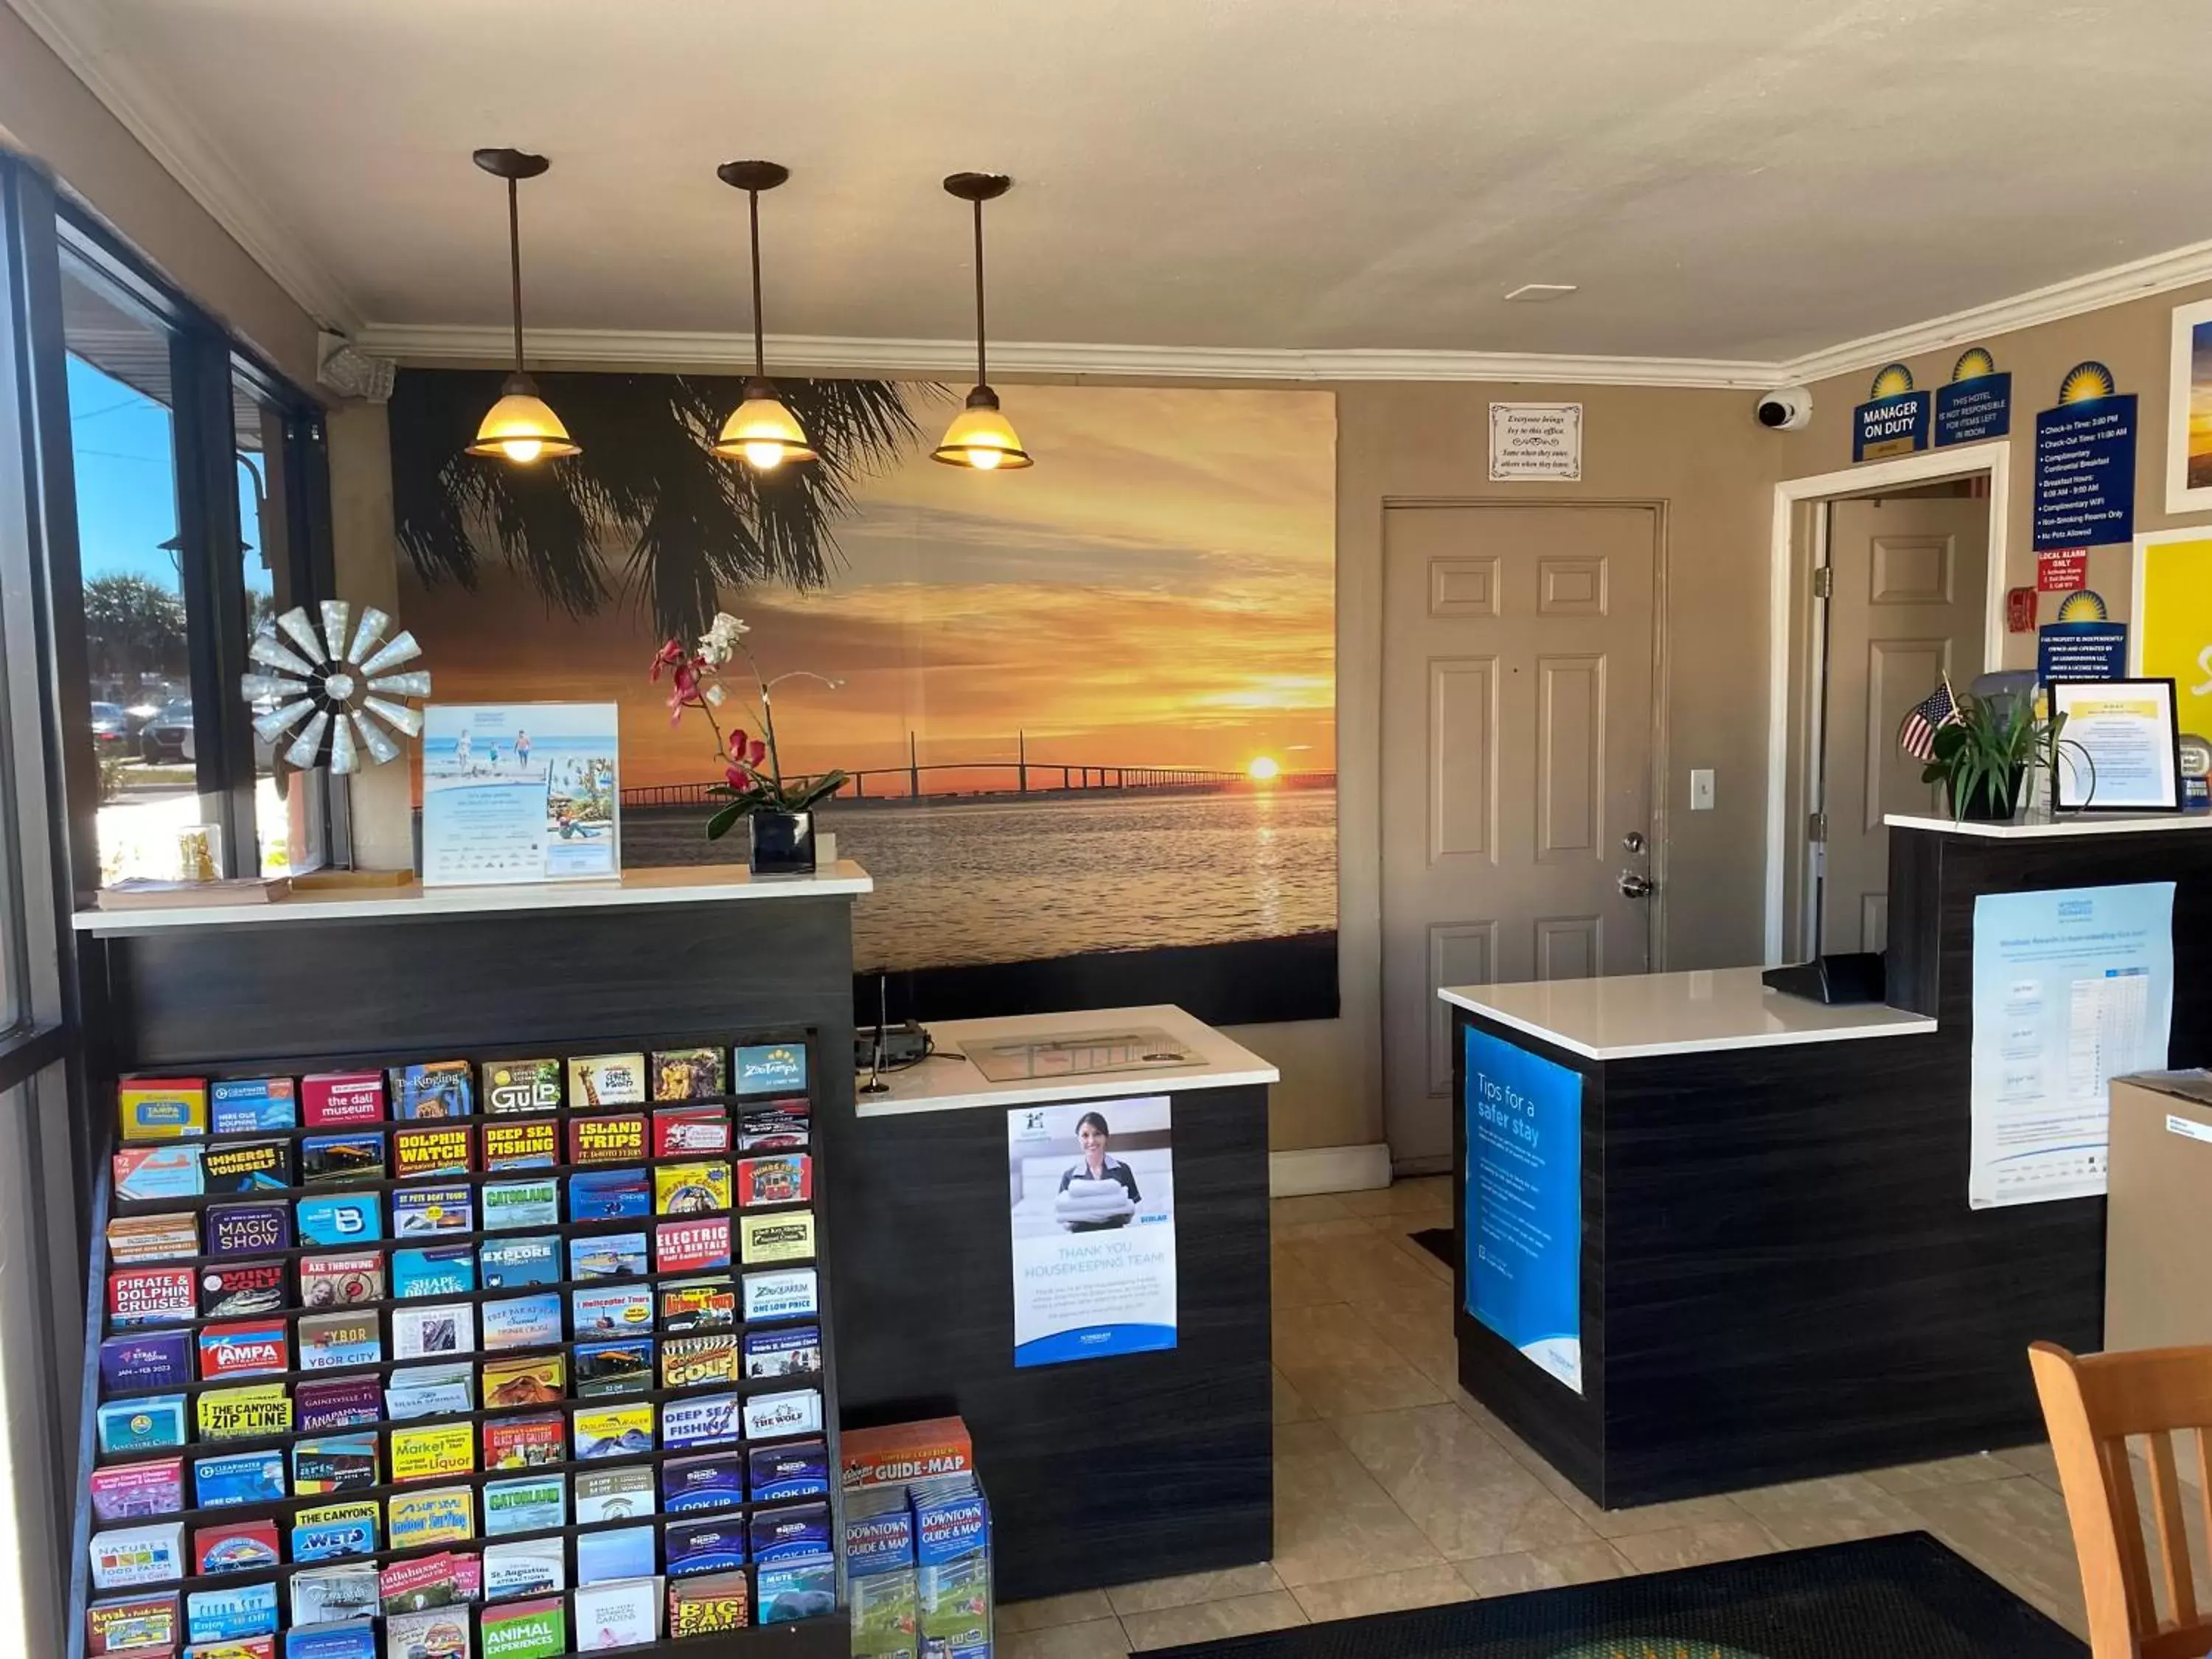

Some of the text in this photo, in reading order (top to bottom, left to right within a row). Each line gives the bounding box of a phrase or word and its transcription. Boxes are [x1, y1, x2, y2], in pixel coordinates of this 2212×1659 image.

[1952, 392, 1992, 406] THIS HOTEL
[1863, 401, 1918, 424] MANAGER
[1938, 399, 2006, 420] IS NOT RESPONSIBLE
[1508, 415, 1564, 424] Everyone brings
[1946, 412, 1997, 430] FOR ITEMS LEFT
[2073, 414, 2118, 429] Time: 3:00 PM
[1865, 417, 1915, 438] ON DUTY
[1955, 427, 1986, 439] IN ROOM
[2045, 427, 2127, 449] Check-Out Time: 11:00 AM
[1537, 449, 1551, 457] they
[2045, 449, 2090, 464] Complimentary
[1539, 461, 1551, 469] they
[2044, 456, 2110, 473] Continental Breakfast
[2043, 475, 2094, 487] Breakfast Hours:
[2057, 483, 2099, 496] AM AM
[2043, 498, 2088, 513] Complimentary
[2042, 509, 2123, 526] Non-Smoking Rooms Only
[2042, 527, 2092, 540] No Pets Allowed
[2039, 549, 2086, 560] LOCAL ALARM
[2053, 560, 2070, 568] ONLY
[414, 1073, 460, 1090] Ringling
[328, 1096, 348, 1107] the
[1478, 1073, 1534, 1117] Tips for a
[321, 1104, 375, 1116] museum
[580, 1121, 641, 1135] ISLAND
[1478, 1102, 1510, 1129] safer
[1512, 1119, 1539, 1148] stay
[399, 1132, 465, 1149] DOLPHIN
[487, 1125, 553, 1141] DEEP SEA
[487, 1138, 554, 1155] FISHING
[580, 1133, 641, 1149] TRIPS
[207, 1147, 275, 1167] IMMERSE
[399, 1144, 467, 1163] WATCH
[209, 1158, 276, 1176] YOURSELF
[218, 1219, 279, 1237] MAGIC
[221, 1233, 278, 1250] SHOW
[657, 1226, 728, 1247] ELECTRIC
[483, 1246, 552, 1262] EXPLORE
[659, 1241, 728, 1256] BIKE RENTALS
[1058, 1241, 1133, 1260] THANK YOU
[308, 1259, 374, 1272] AXE THROWING
[1024, 1252, 1165, 1279] HOUSEKEEPING TEAM!
[223, 1268, 281, 1281] MINI
[117, 1275, 189, 1290] PIRATE &
[223, 1277, 281, 1290] GOLF
[411, 1276, 456, 1289] SHAPE
[117, 1286, 189, 1301] DOLPHIN
[117, 1297, 190, 1312] CRUISES
[582, 1295, 650, 1308] Helicopter Tours
[753, 1300, 810, 1313] ONE LOW PRICE
[330, 1328, 366, 1343] YBOR
[310, 1352, 375, 1367] YBOR CITY
[118, 1367, 151, 1377] JAN FEB
[667, 1359, 732, 1385] GOLF
[212, 1402, 287, 1415] THE CANYONS
[394, 1394, 461, 1408] SILVER SPRINGS
[212, 1412, 288, 1429] ZIP LINE
[303, 1408, 358, 1430] KANAPAHA
[665, 1406, 734, 1423] DEEP SEA
[754, 1413, 803, 1427] THE WOLF
[580, 1422, 617, 1431] DOLPHIN
[670, 1421, 729, 1436] FISHING
[493, 1436, 513, 1447] GLASS
[527, 1431, 552, 1442] GALLERY
[396, 1440, 444, 1456] Market
[215, 1461, 260, 1471] CLEARWATER
[300, 1464, 334, 1475] arts
[429, 1457, 470, 1470] Liquor
[875, 1455, 964, 1480] GUIDE-MAP
[765, 1486, 819, 1500] LOOK UP
[675, 1498, 731, 1511] LOOK UP
[300, 1507, 375, 1524] THE CANYONS
[922, 1504, 982, 1526] DOWNTOWN
[392, 1514, 467, 1534] Indoor Surfing
[848, 1519, 908, 1540] DOWNTOWN
[922, 1522, 982, 1543] GUIDE & MAP
[99, 1540, 168, 1554] NATURE'S
[848, 1537, 908, 1557] GUIDE & MAP
[101, 1563, 172, 1576] FOOD PATCH
[380, 1559, 447, 1585] Tallahassee
[504, 1567, 549, 1578] Augustine
[496, 1574, 545, 1585] ATTRACTIONS
[766, 1574, 792, 1583] MOTE
[92, 1608, 126, 1623] Kayak
[680, 1600, 738, 1617] BIG
[194, 1621, 224, 1632] Enjoy
[596, 1614, 636, 1624] GARDENS
[679, 1613, 735, 1630] CAT
[487, 1621, 553, 1644] ANIMAL
[678, 1623, 737, 1636] HABITAT
[487, 1635, 554, 1655] EXPERIENCES
